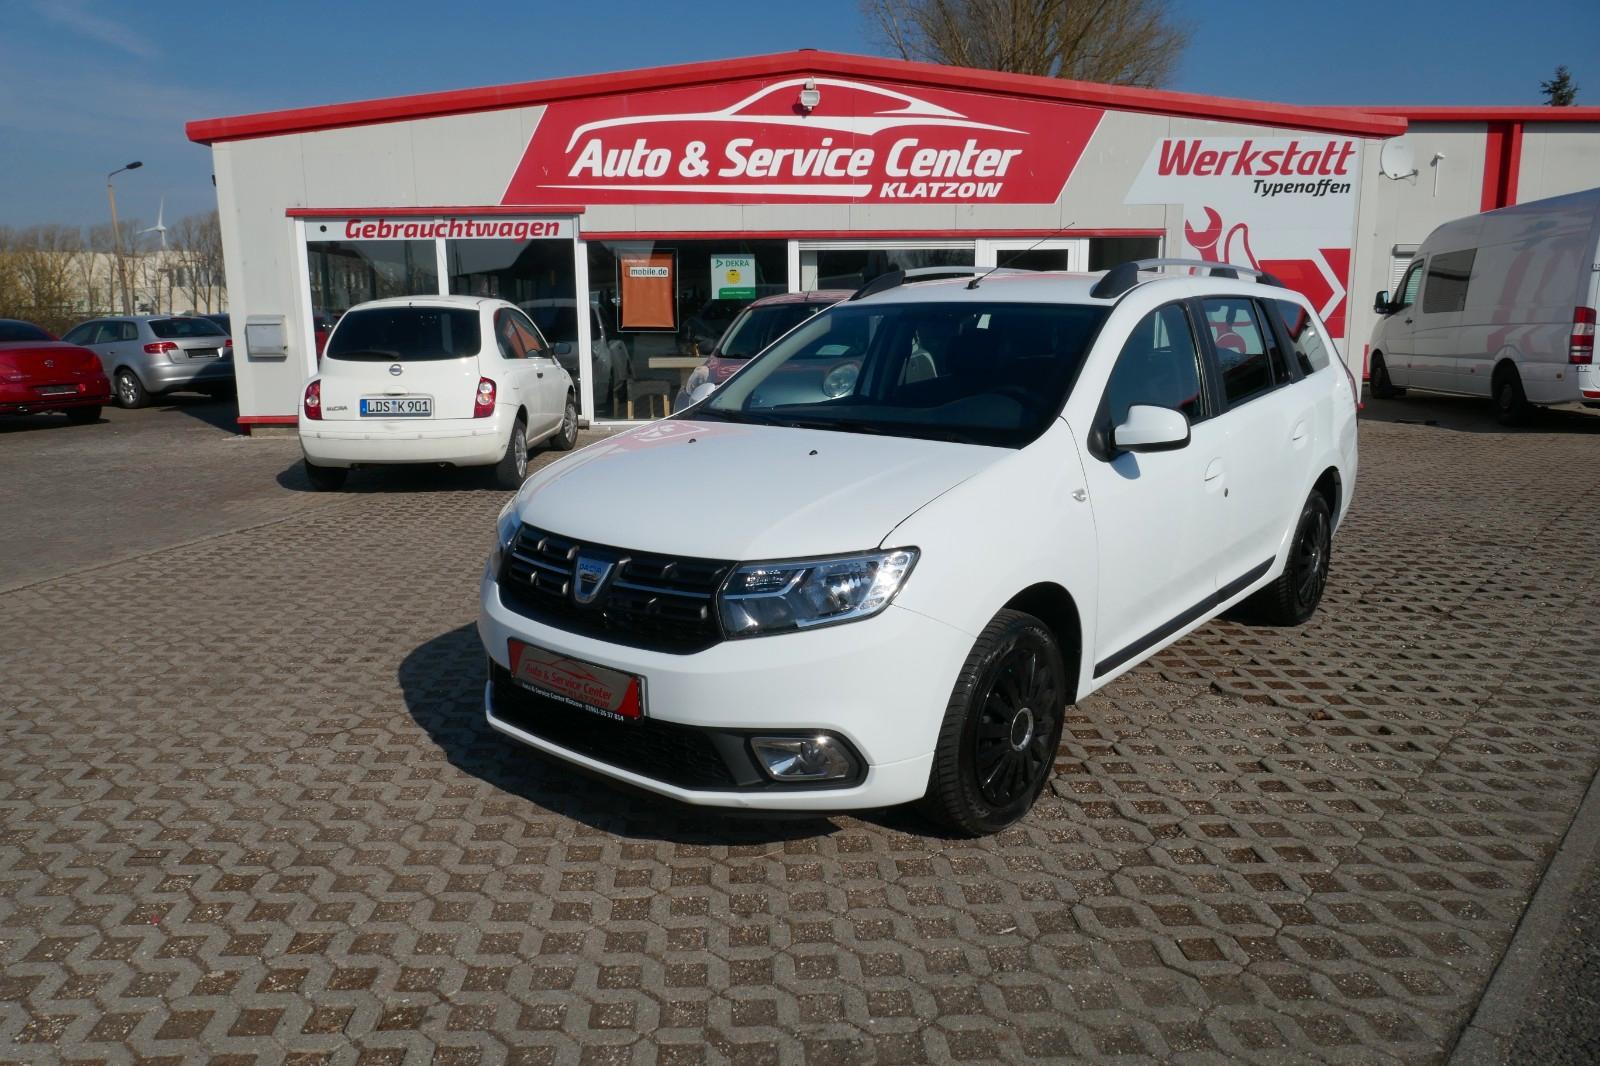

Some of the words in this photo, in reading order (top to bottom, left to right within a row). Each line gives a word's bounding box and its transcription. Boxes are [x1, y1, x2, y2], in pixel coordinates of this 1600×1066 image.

[567, 138, 672, 178] Auto
[679, 140, 710, 178] &
[718, 136, 875, 178] Service
[885, 136, 1023, 178] Center
[1158, 139, 1357, 177] Werkstatt
[880, 182, 1004, 198] KLATZOW
[1254, 179, 1351, 197] Typenoffen
[345, 218, 560, 243] Gebrauchtwagen
[631, 268, 668, 276] mobile.de
[725, 260, 750, 268] DEKRA
[367, 401, 390, 412] LDS
[551, 672, 582, 689] Service
[583, 682, 612, 700] Center
